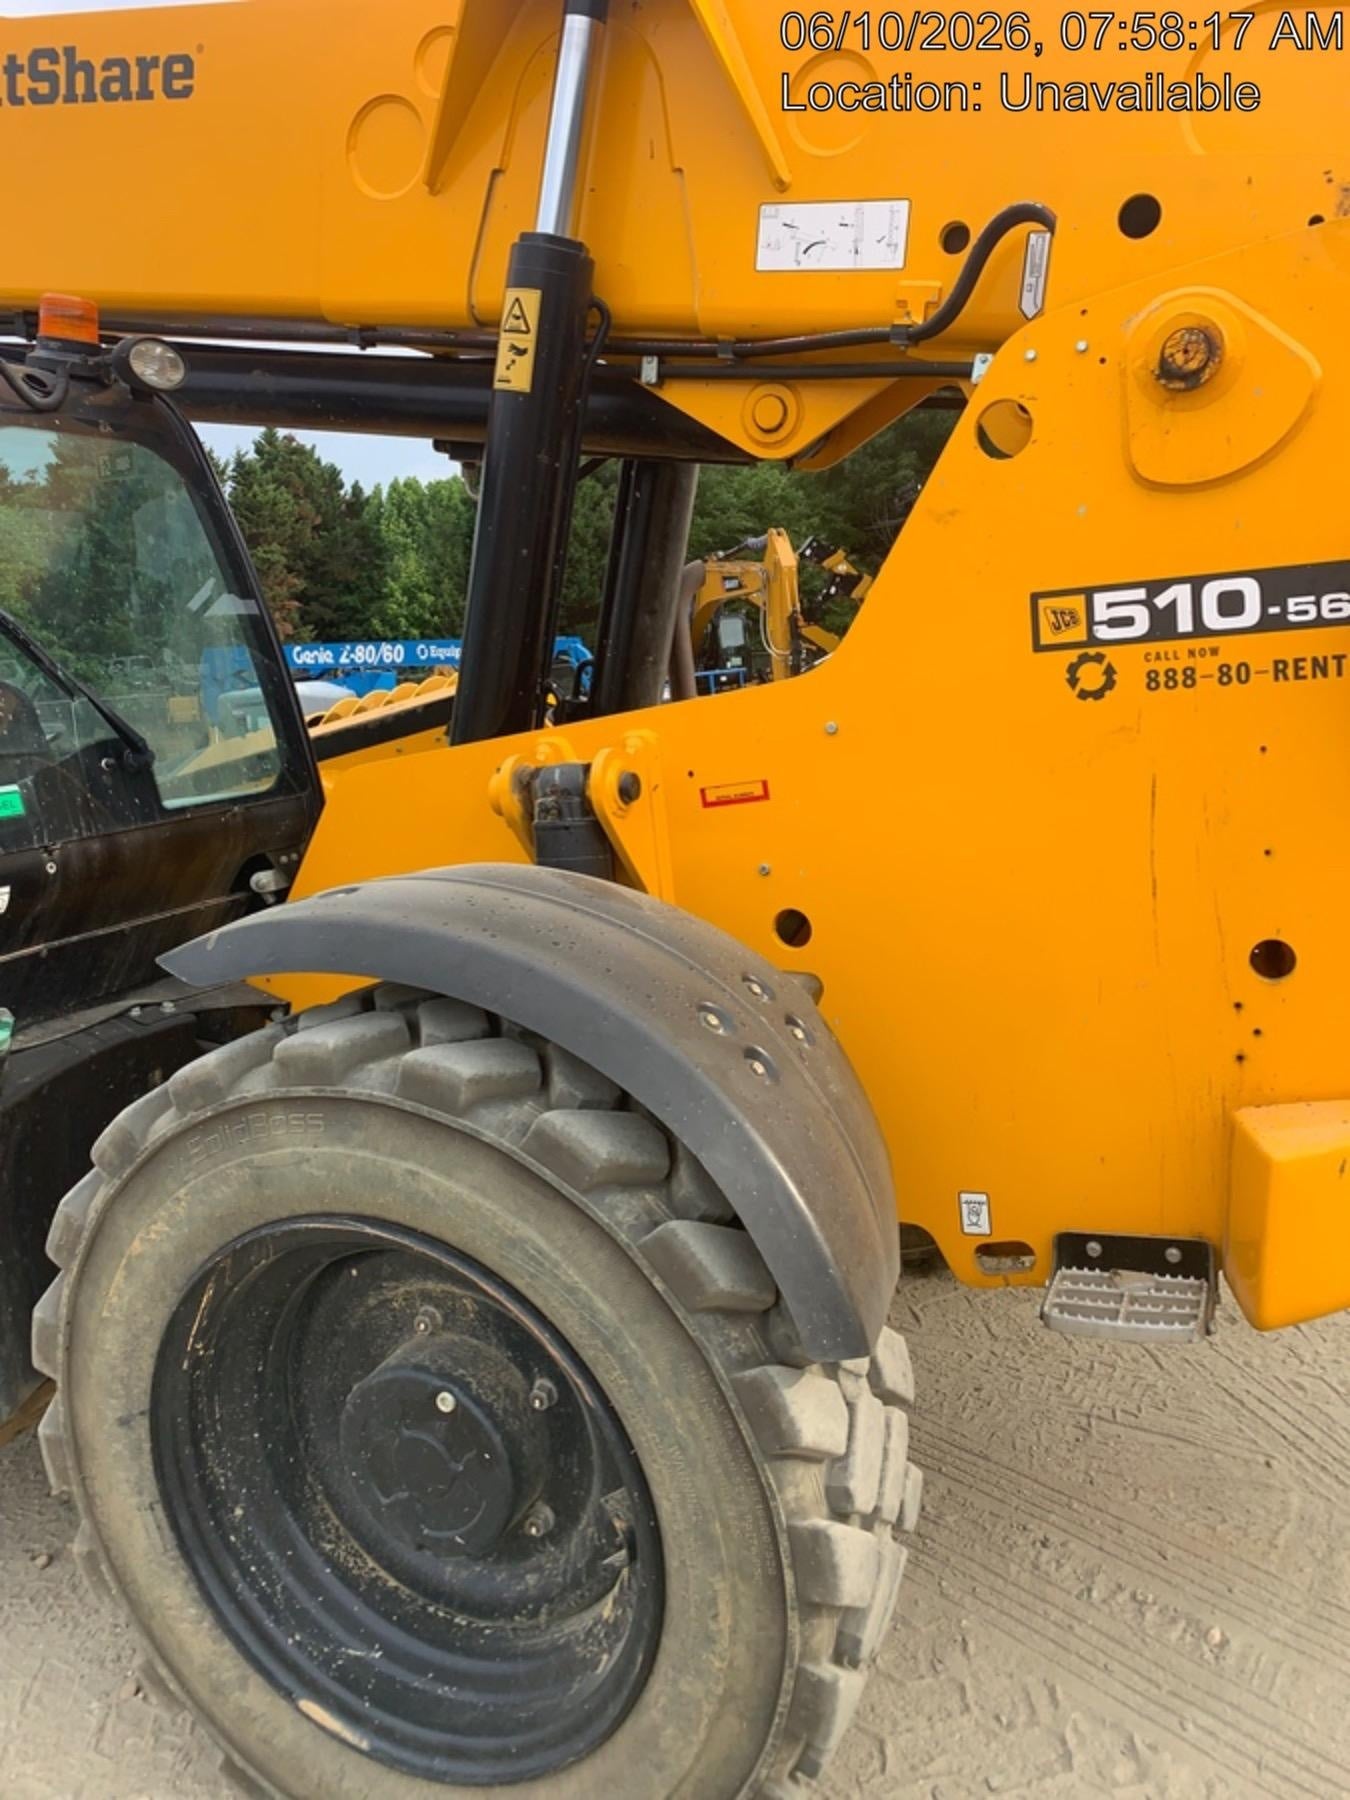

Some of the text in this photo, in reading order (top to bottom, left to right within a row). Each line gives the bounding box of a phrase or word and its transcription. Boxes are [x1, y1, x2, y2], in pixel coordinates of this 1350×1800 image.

[0, 46, 196, 106] tShare
[292, 642, 405, 666] Genie Z-80/60
[1143, 646, 1221, 663] CALL NOW
[1145, 653, 1348, 692] 888-80-RENT
